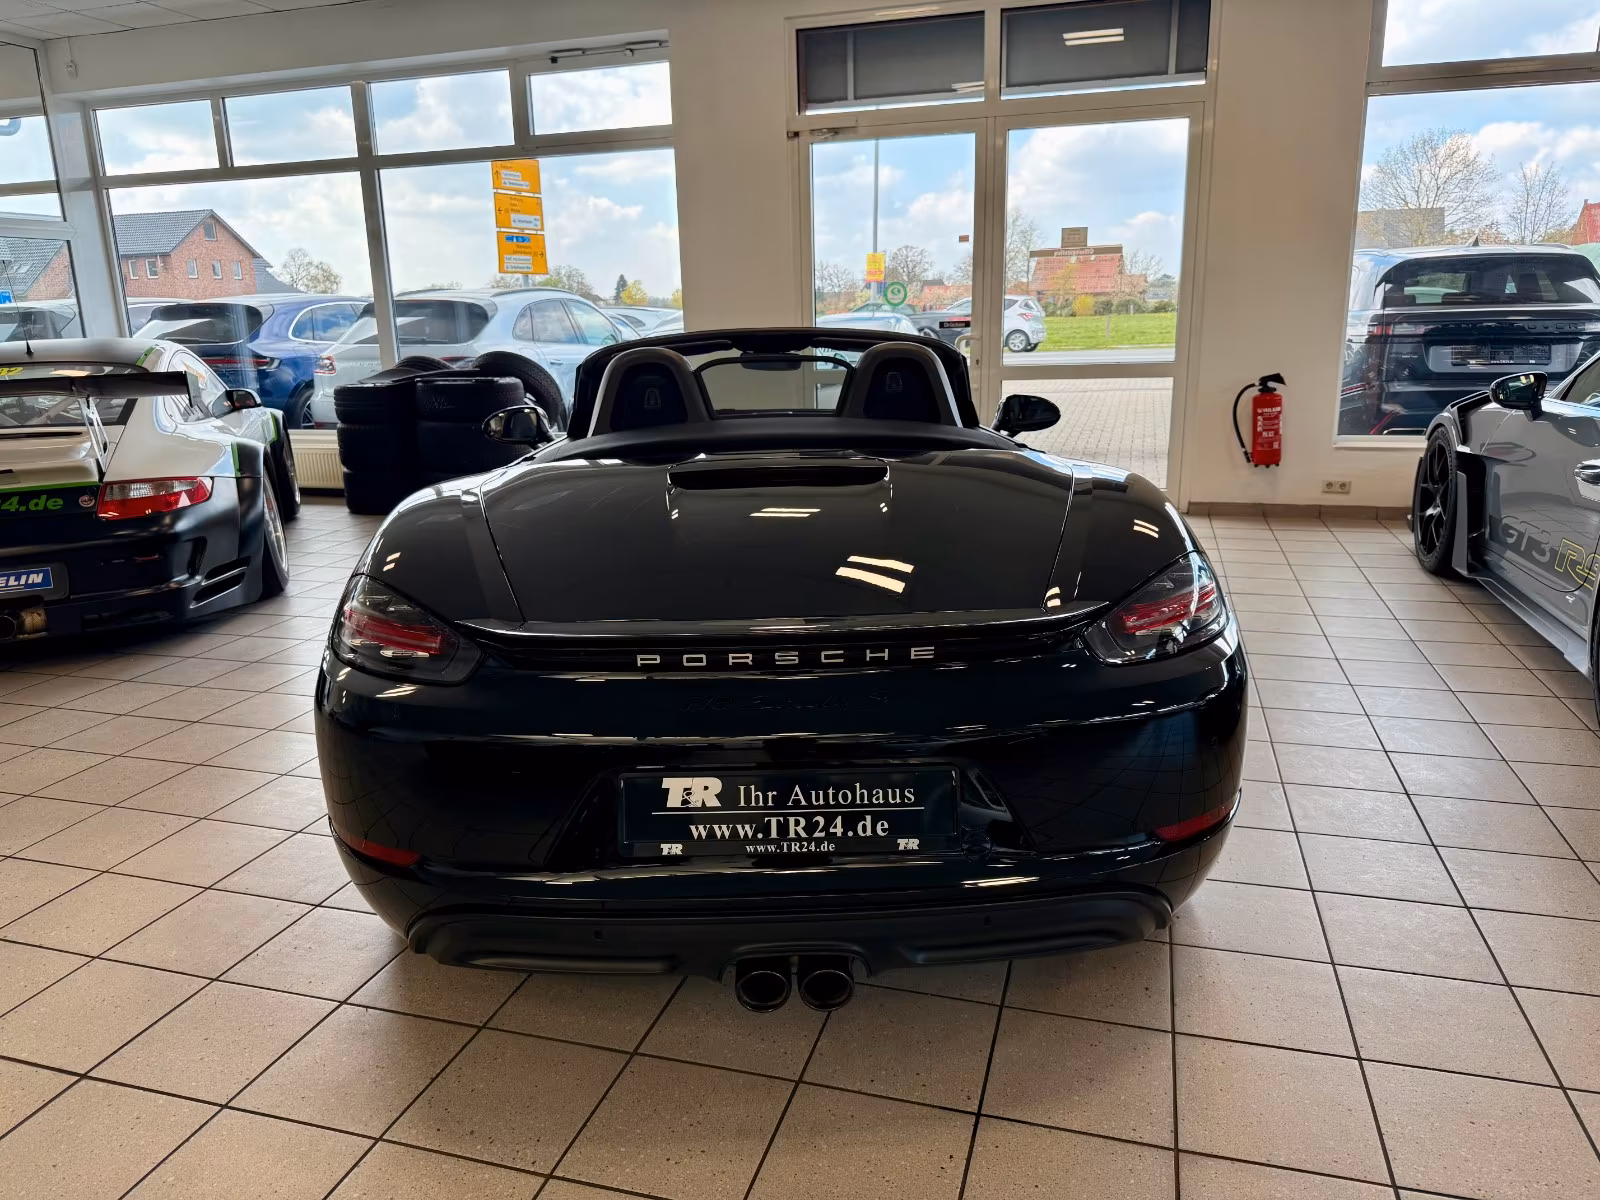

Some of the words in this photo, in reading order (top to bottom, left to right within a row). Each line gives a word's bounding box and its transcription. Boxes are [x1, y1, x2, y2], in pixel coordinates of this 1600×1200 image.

[0, 495, 64, 512] 4.de
[636, 646, 935, 667] PORSCHE
[737, 784, 778, 808] Ihr
[786, 782, 915, 806] Autohaus
[688, 814, 889, 841] www.TR24.de
[745, 840, 836, 853] www.TR24.de
